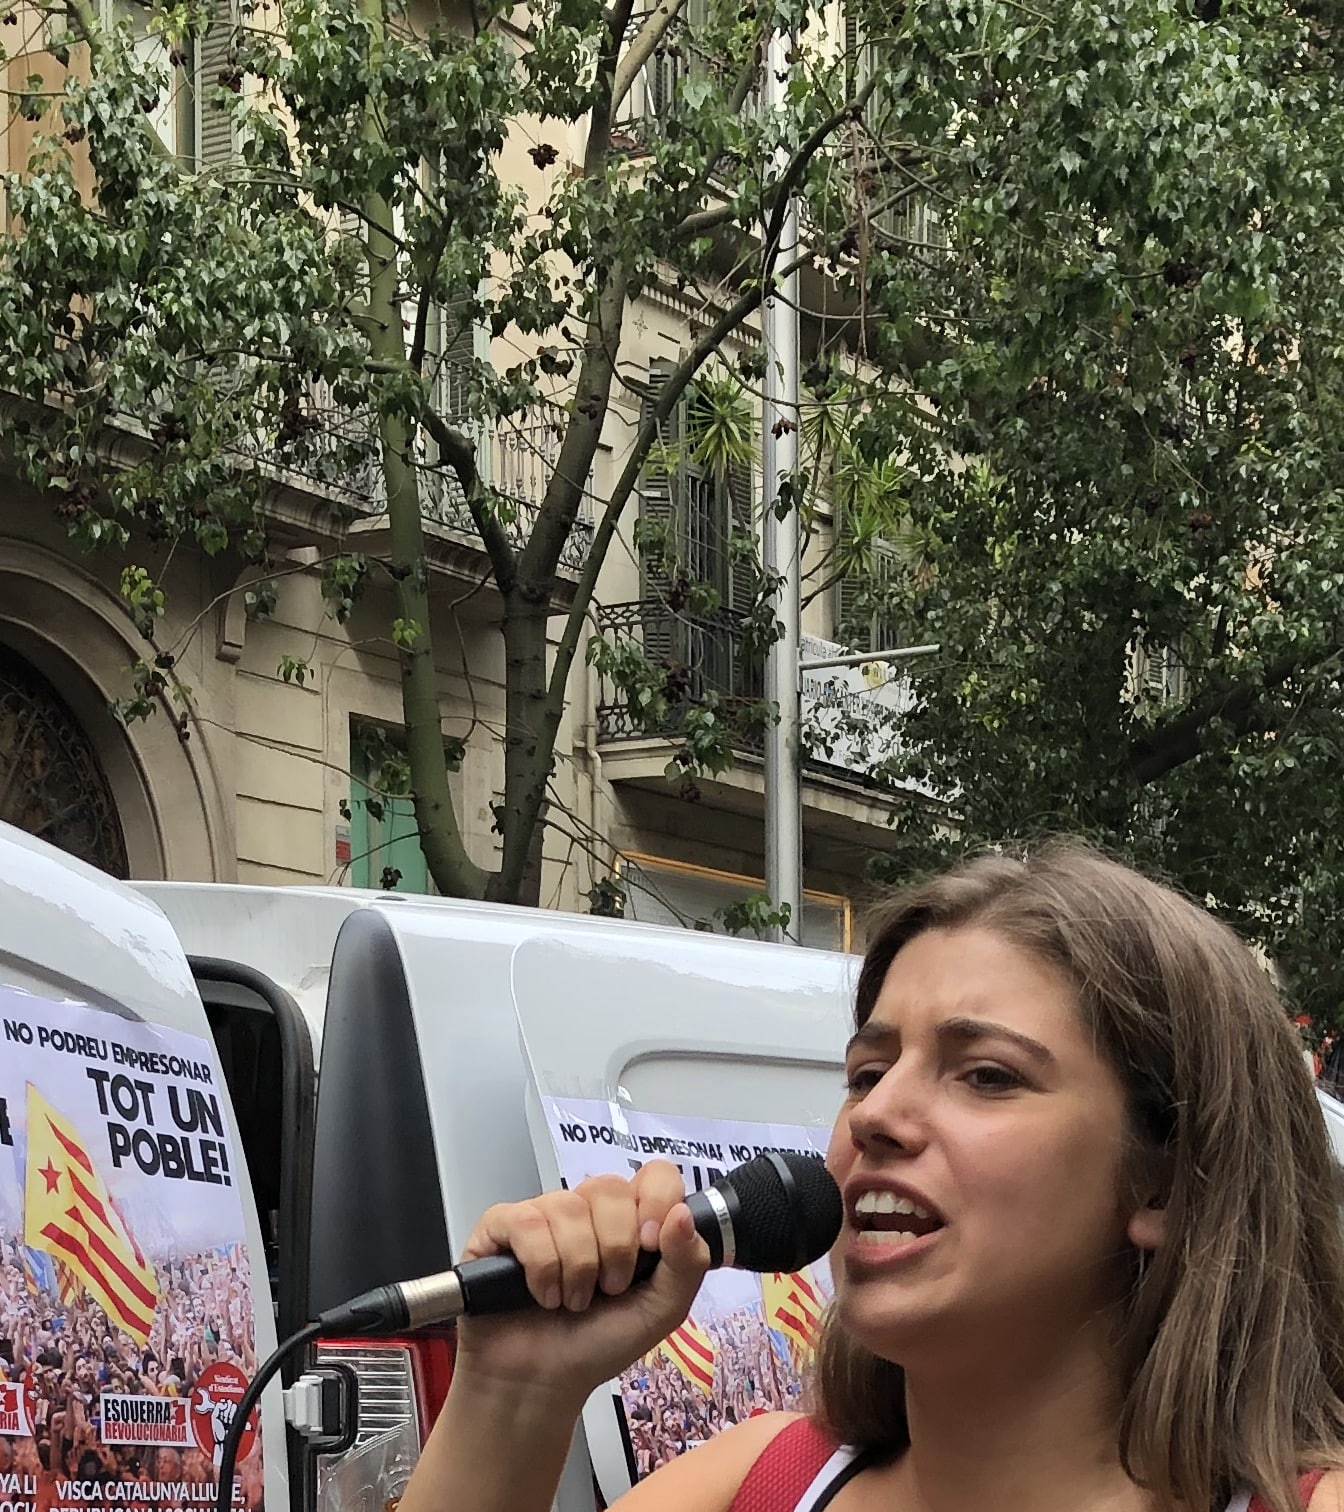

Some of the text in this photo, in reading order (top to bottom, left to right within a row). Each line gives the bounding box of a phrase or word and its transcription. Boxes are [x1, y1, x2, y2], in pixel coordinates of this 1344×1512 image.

[3, 1018, 214, 1085] NO PODREU EMPRESONAR
[85, 1067, 226, 1138] TOT UN
[559, 1123, 587, 1144] NO
[106, 1121, 233, 1188] POBLE!
[729, 1144, 752, 1162] NO
[104, 1398, 172, 1425] ESQUERRA
[104, 1422, 188, 1443] REVOLUCIONARIA
[56, 1480, 246, 1504] VISCA CATALUNYA LLIUE,
